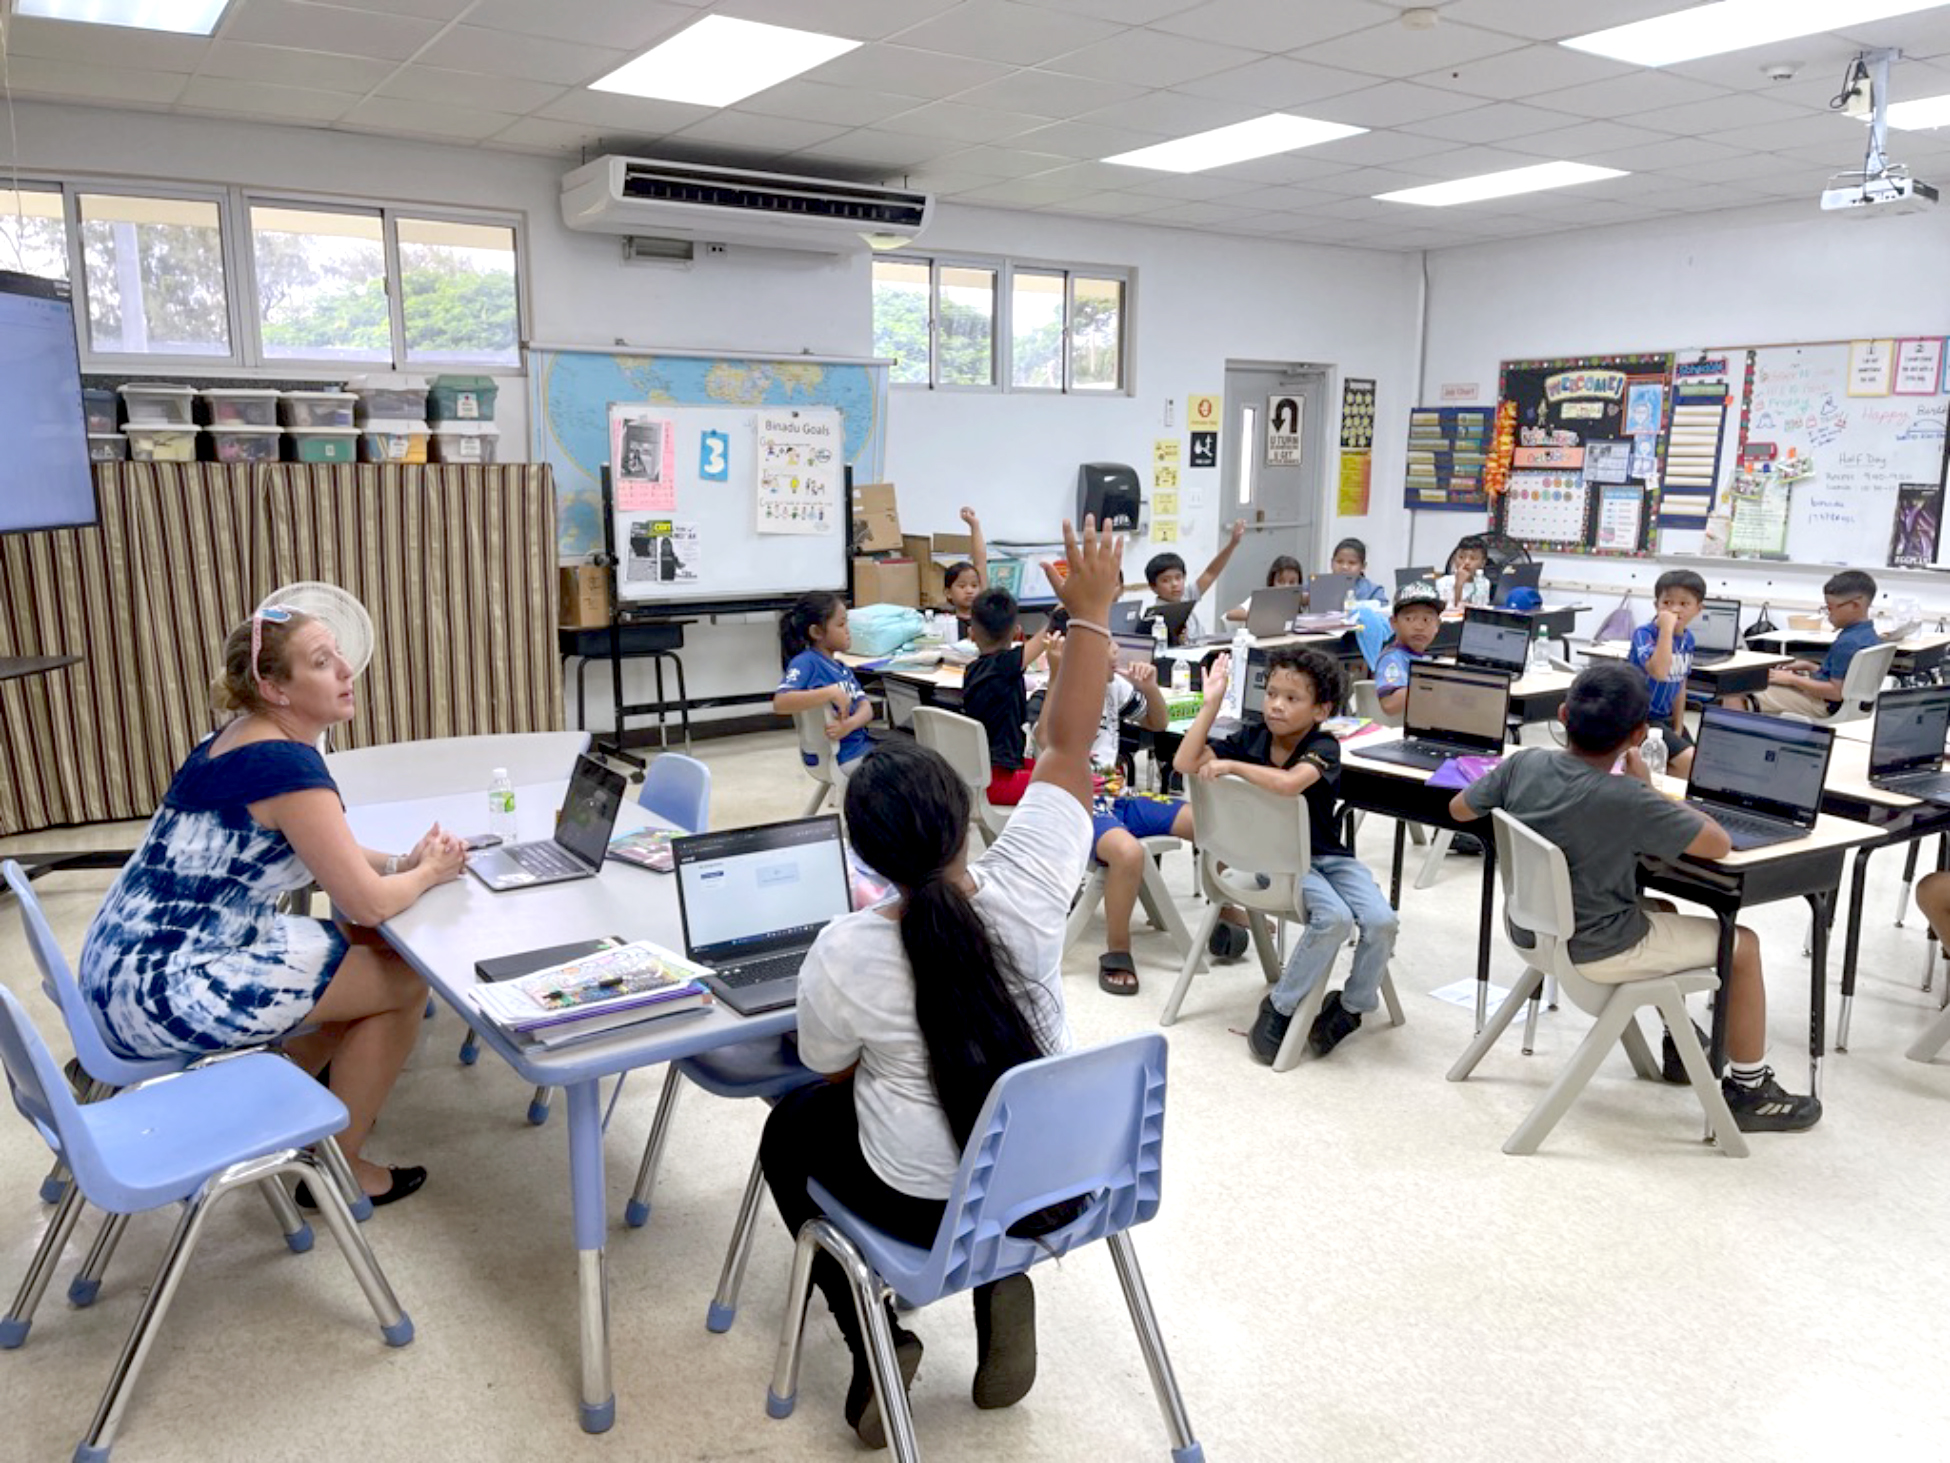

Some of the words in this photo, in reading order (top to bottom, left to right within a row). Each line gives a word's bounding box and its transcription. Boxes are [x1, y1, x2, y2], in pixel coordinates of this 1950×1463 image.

[1548, 374, 1623, 398] WELCOME!
[765, 420, 800, 433] Binadu
[803, 423, 831, 436] Goals
[703, 437, 725, 474] 3
[1839, 452, 1864, 466] Half
[1867, 453, 1887, 469] Day
